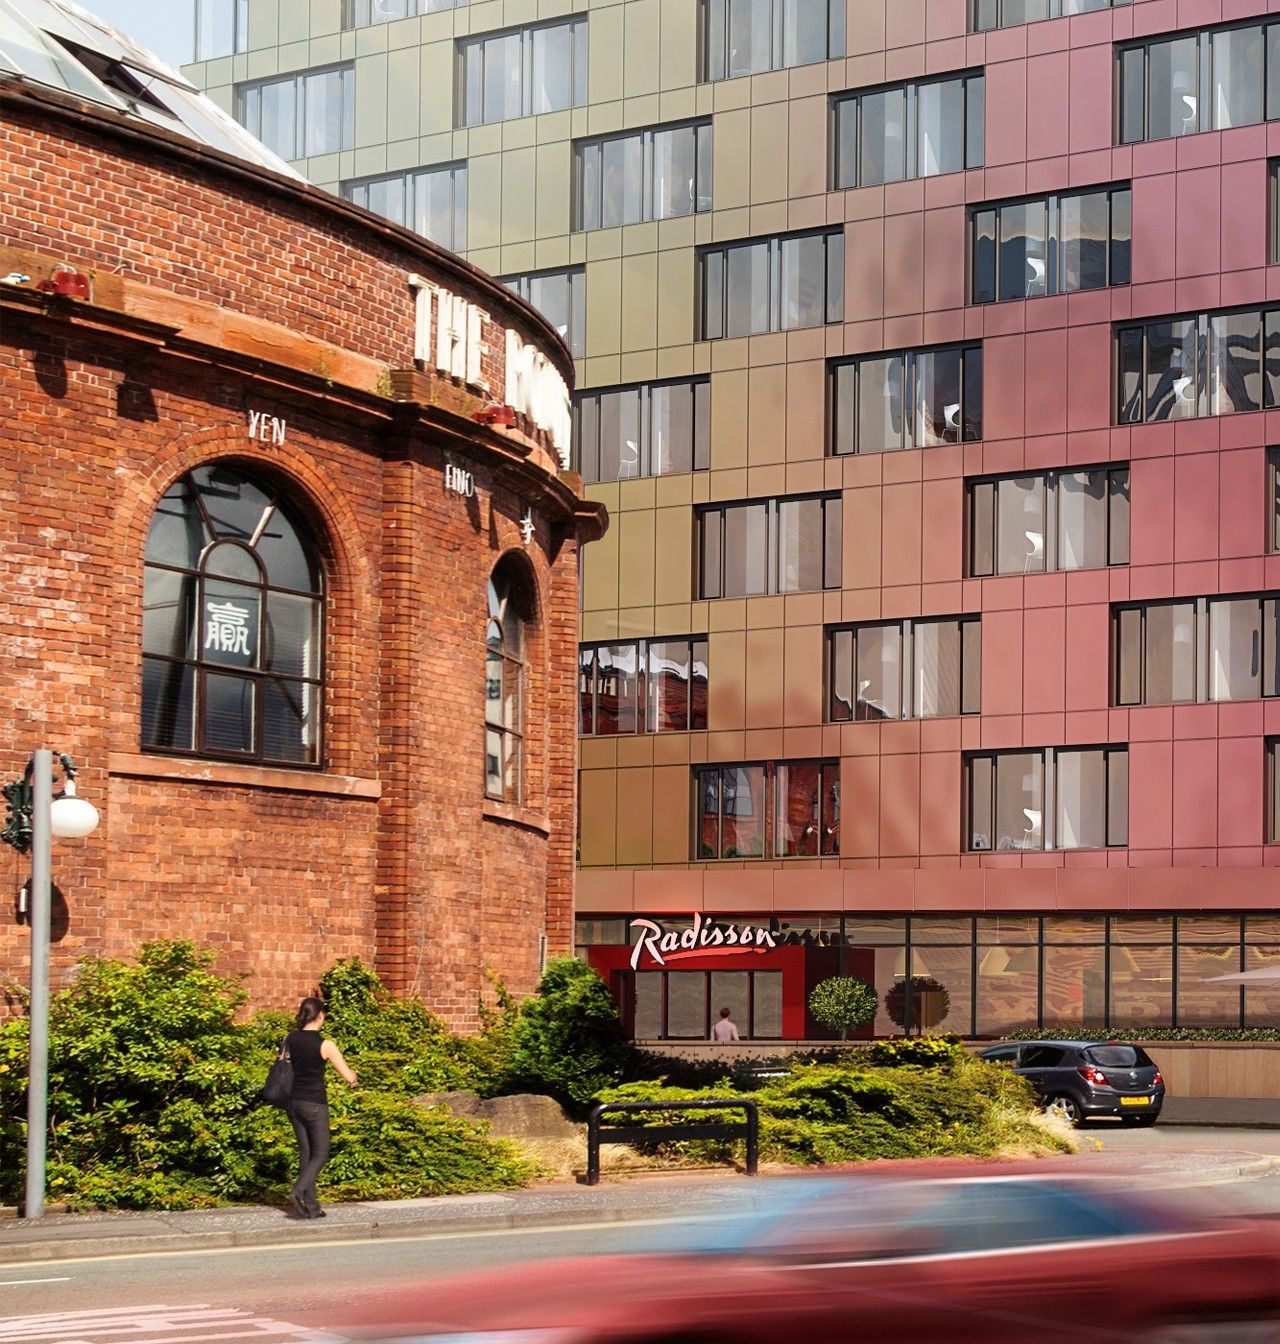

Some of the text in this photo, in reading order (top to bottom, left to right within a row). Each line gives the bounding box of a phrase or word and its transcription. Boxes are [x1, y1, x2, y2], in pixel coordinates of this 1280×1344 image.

[408, 273, 490, 392] THE
[248, 409, 286, 446] YEN
[630, 911, 781, 971] Radisson
